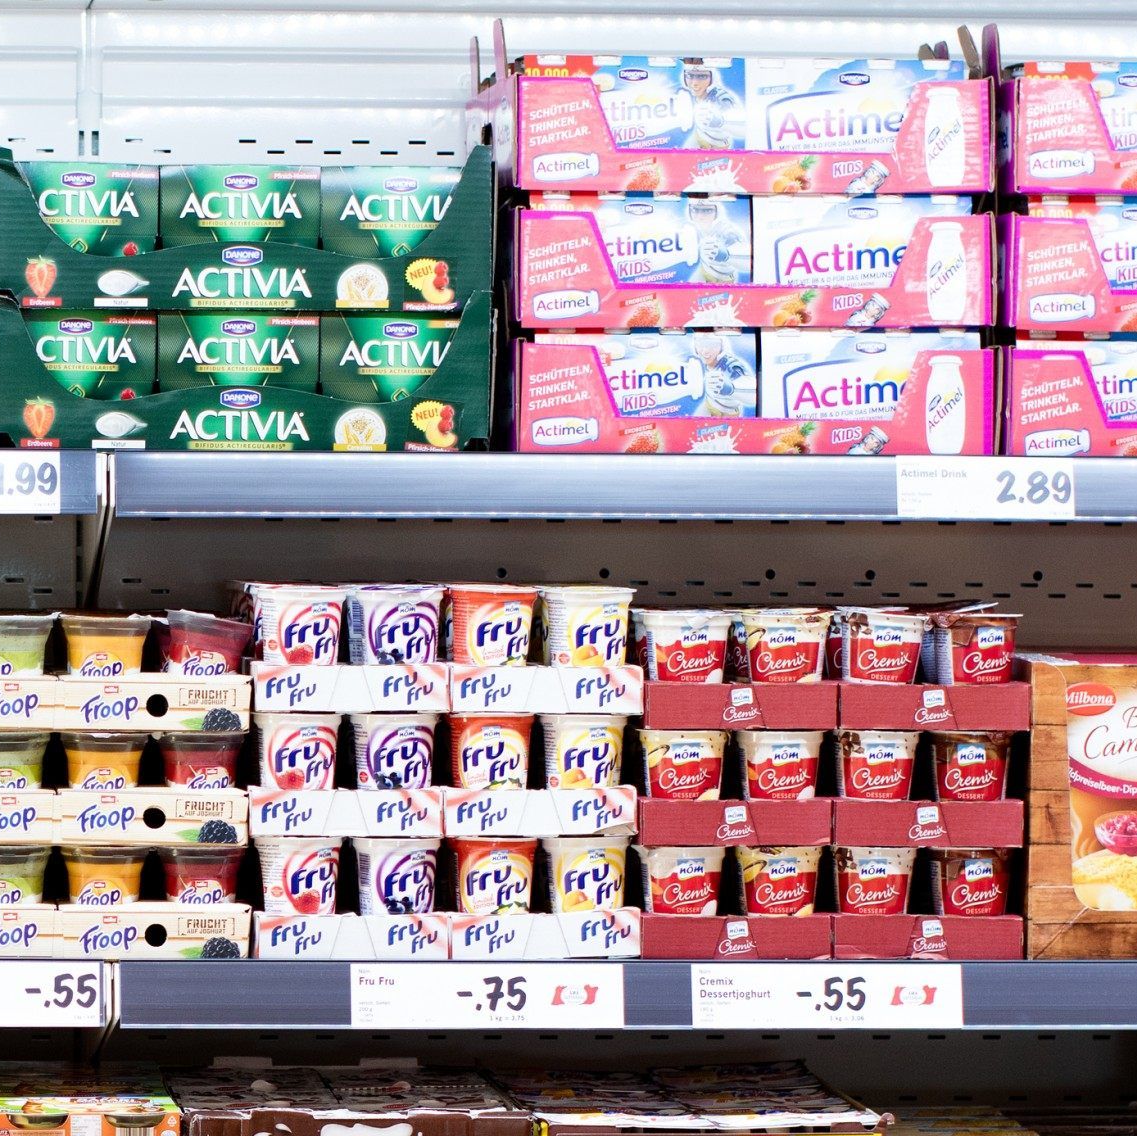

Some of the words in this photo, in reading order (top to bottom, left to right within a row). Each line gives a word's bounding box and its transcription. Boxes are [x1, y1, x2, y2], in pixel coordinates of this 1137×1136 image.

[529, 100, 593, 120] SCHÜTTELN,
[530, 117, 577, 133] TRINKEN,
[777, 112, 903, 141] Actime
[529, 126, 591, 146] STARTKLAR.
[537, 159, 590, 173] Actimel
[833, 162, 863, 178] KIDS
[225, 248, 260, 260] DANONE
[408, 265, 433, 281] NEU!
[172, 268, 312, 299] ACTIVIA
[536, 297, 590, 312] Actimel
[833, 293, 863, 310] KIDS
[170, 410, 309, 441] ACTIVIA
[901, 469, 937, 478] Actimel
[942, 469, 966, 478] Drink
[996, 470, 1071, 504] 2.89
[667, 651, 719, 676] Cremix
[963, 655, 1011, 675] Cremix
[188, 689, 228, 701] FRUCHT
[81, 696, 138, 723] Froop
[359, 977, 375, 985] Fru
[379, 977, 395, 985] Fru
[699, 977, 733, 986] Cremix
[25, 973, 97, 1008] -.55
[457, 976, 527, 1011] -.75
[700, 989, 771, 999] Dessertjoghurt
[797, 977, 866, 1011] -.55
